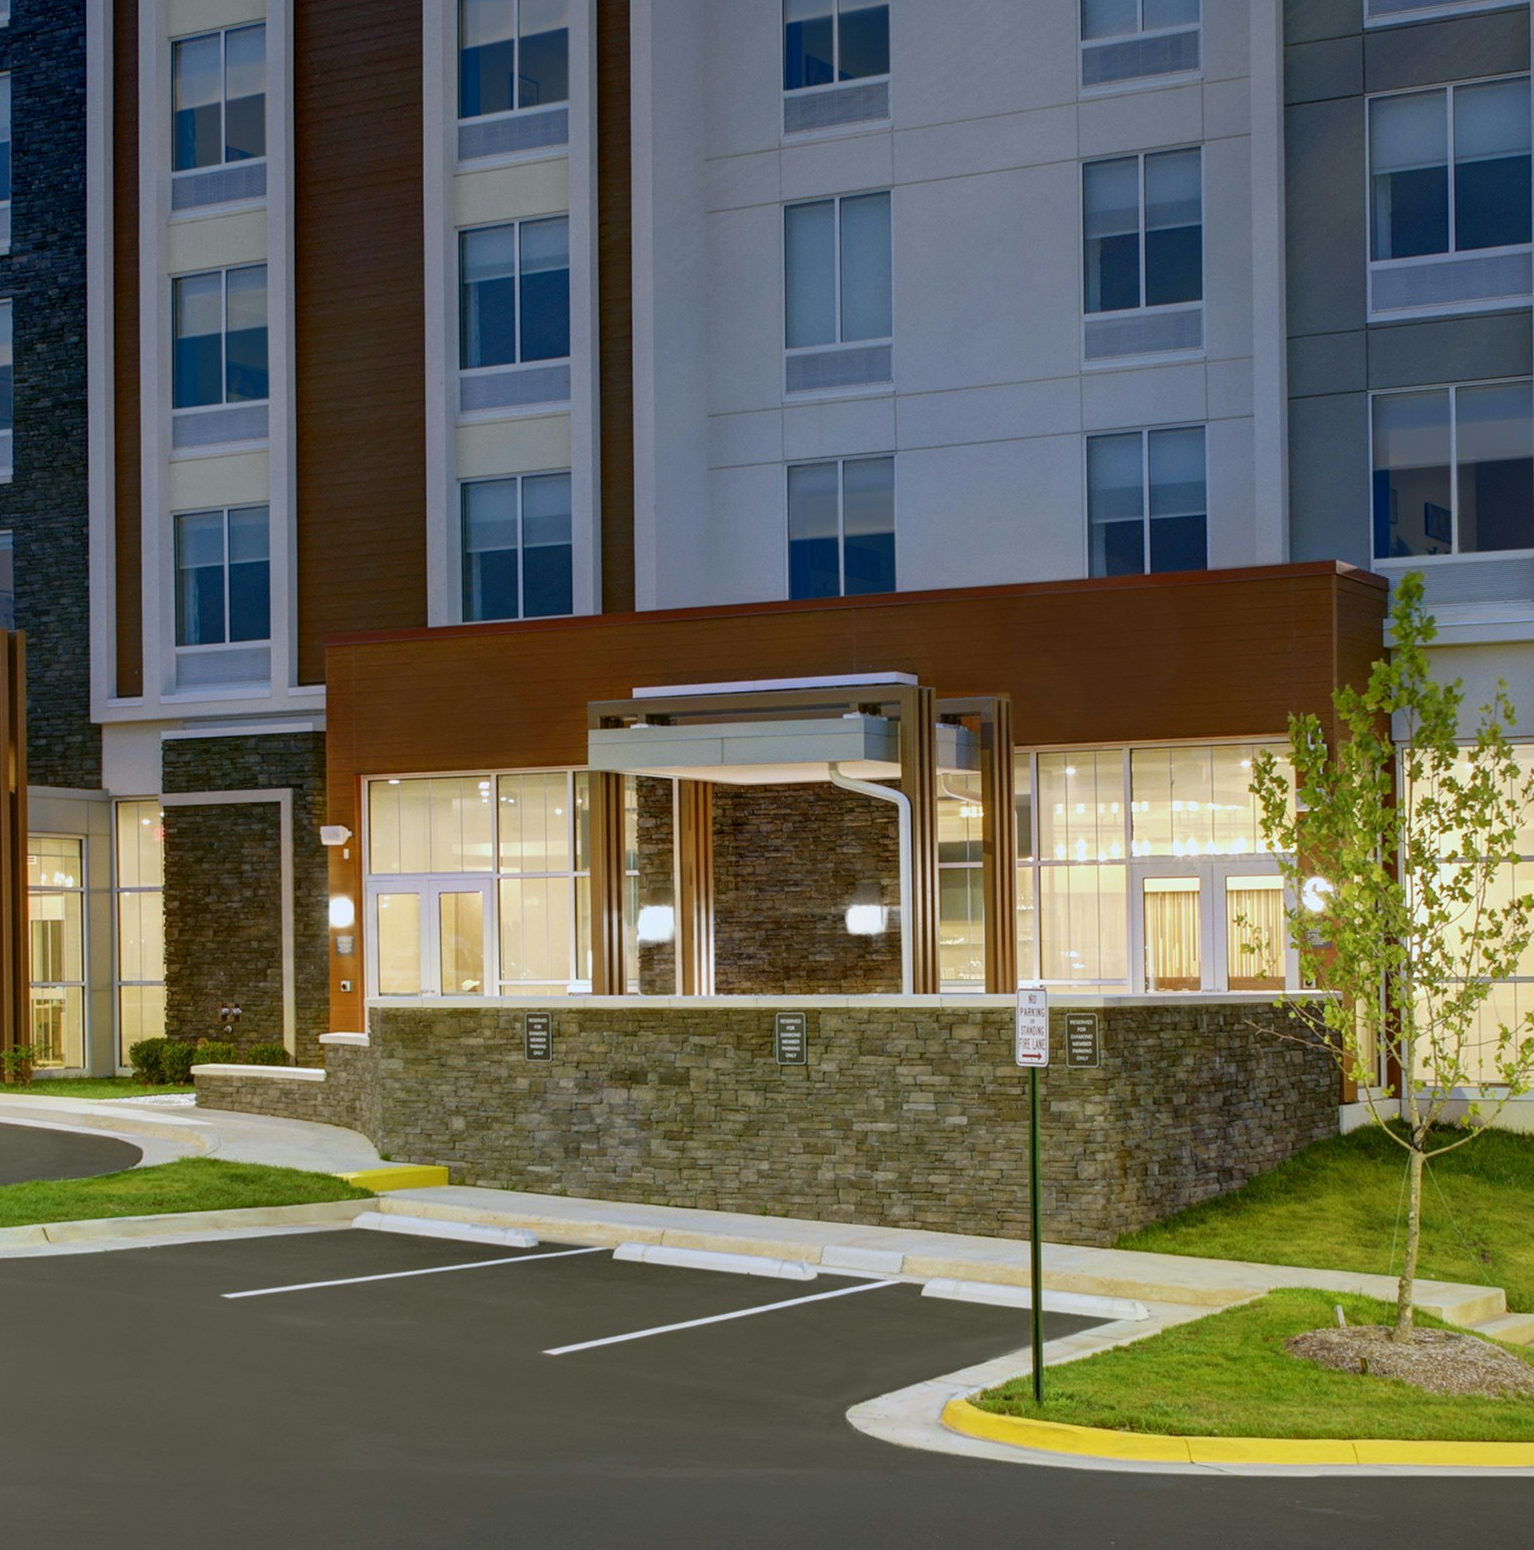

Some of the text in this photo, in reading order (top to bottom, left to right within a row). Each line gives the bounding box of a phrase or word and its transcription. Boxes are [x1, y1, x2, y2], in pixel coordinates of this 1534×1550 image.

[1028, 994, 1036, 1004] NO
[1020, 1008, 1044, 1017] PARKING
[1021, 1026, 1044, 1035] STANDING
[1020, 1038, 1045, 1050] FIRE LANE
